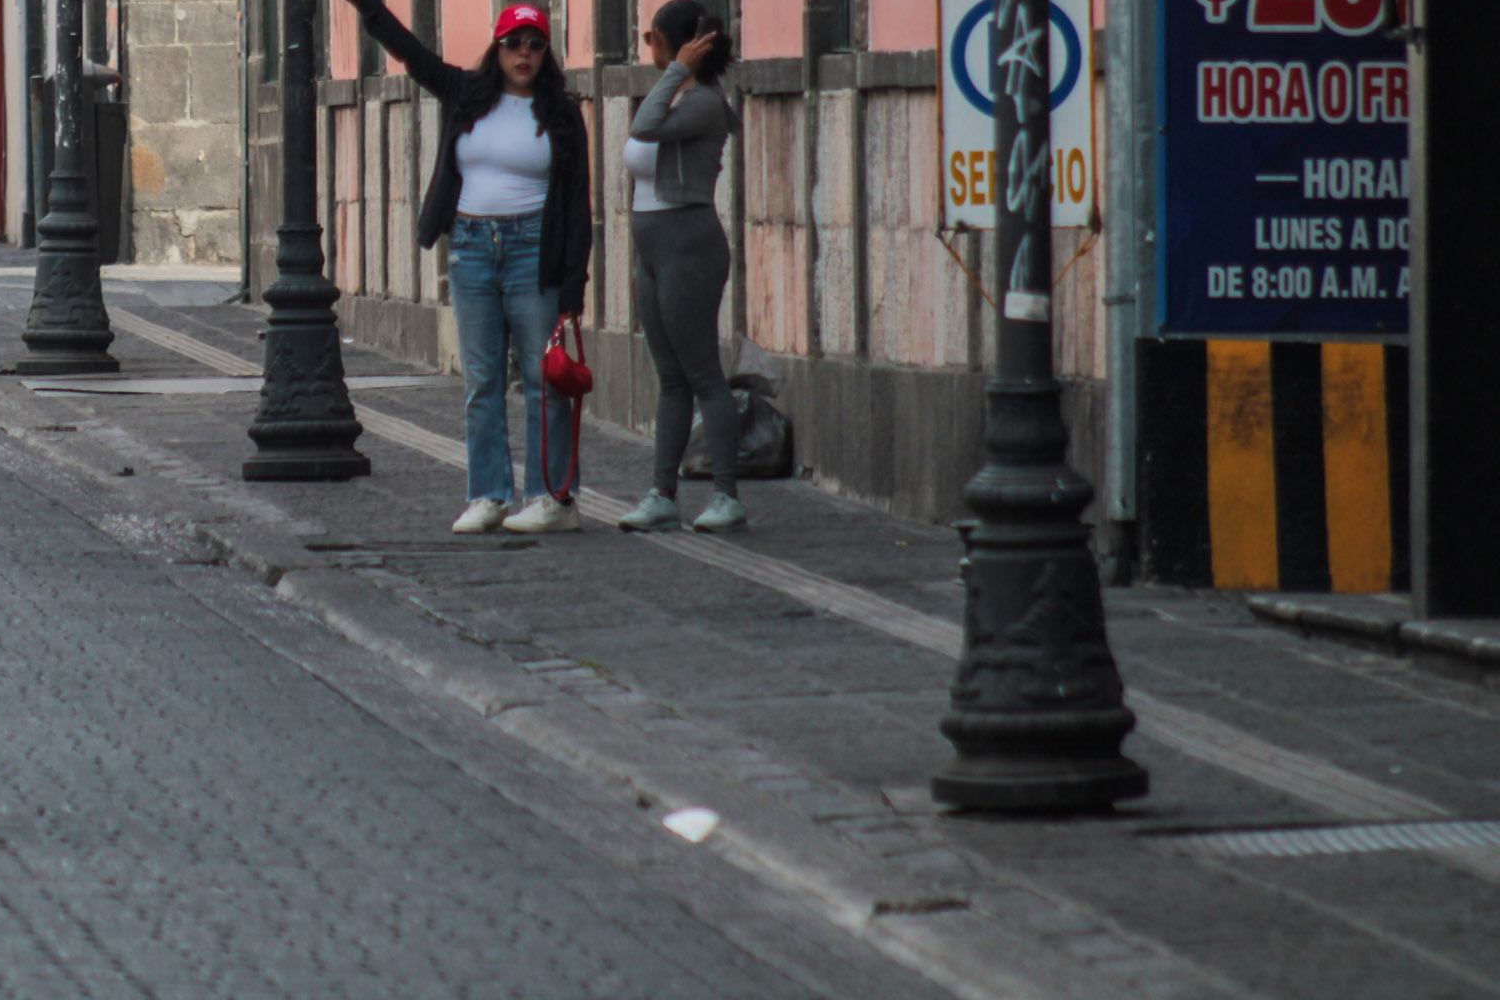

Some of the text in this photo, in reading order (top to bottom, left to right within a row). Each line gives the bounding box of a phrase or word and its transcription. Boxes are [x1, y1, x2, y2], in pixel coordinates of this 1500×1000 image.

[1198, 61, 1315, 123] HORA
[1317, 61, 1353, 124] O
[1255, 217, 1342, 250] LUNES
[1351, 217, 1369, 250] A
[1208, 266, 1243, 298] DE
[1252, 266, 1312, 298] 8:00
[1320, 266, 1387, 298] A.M.
